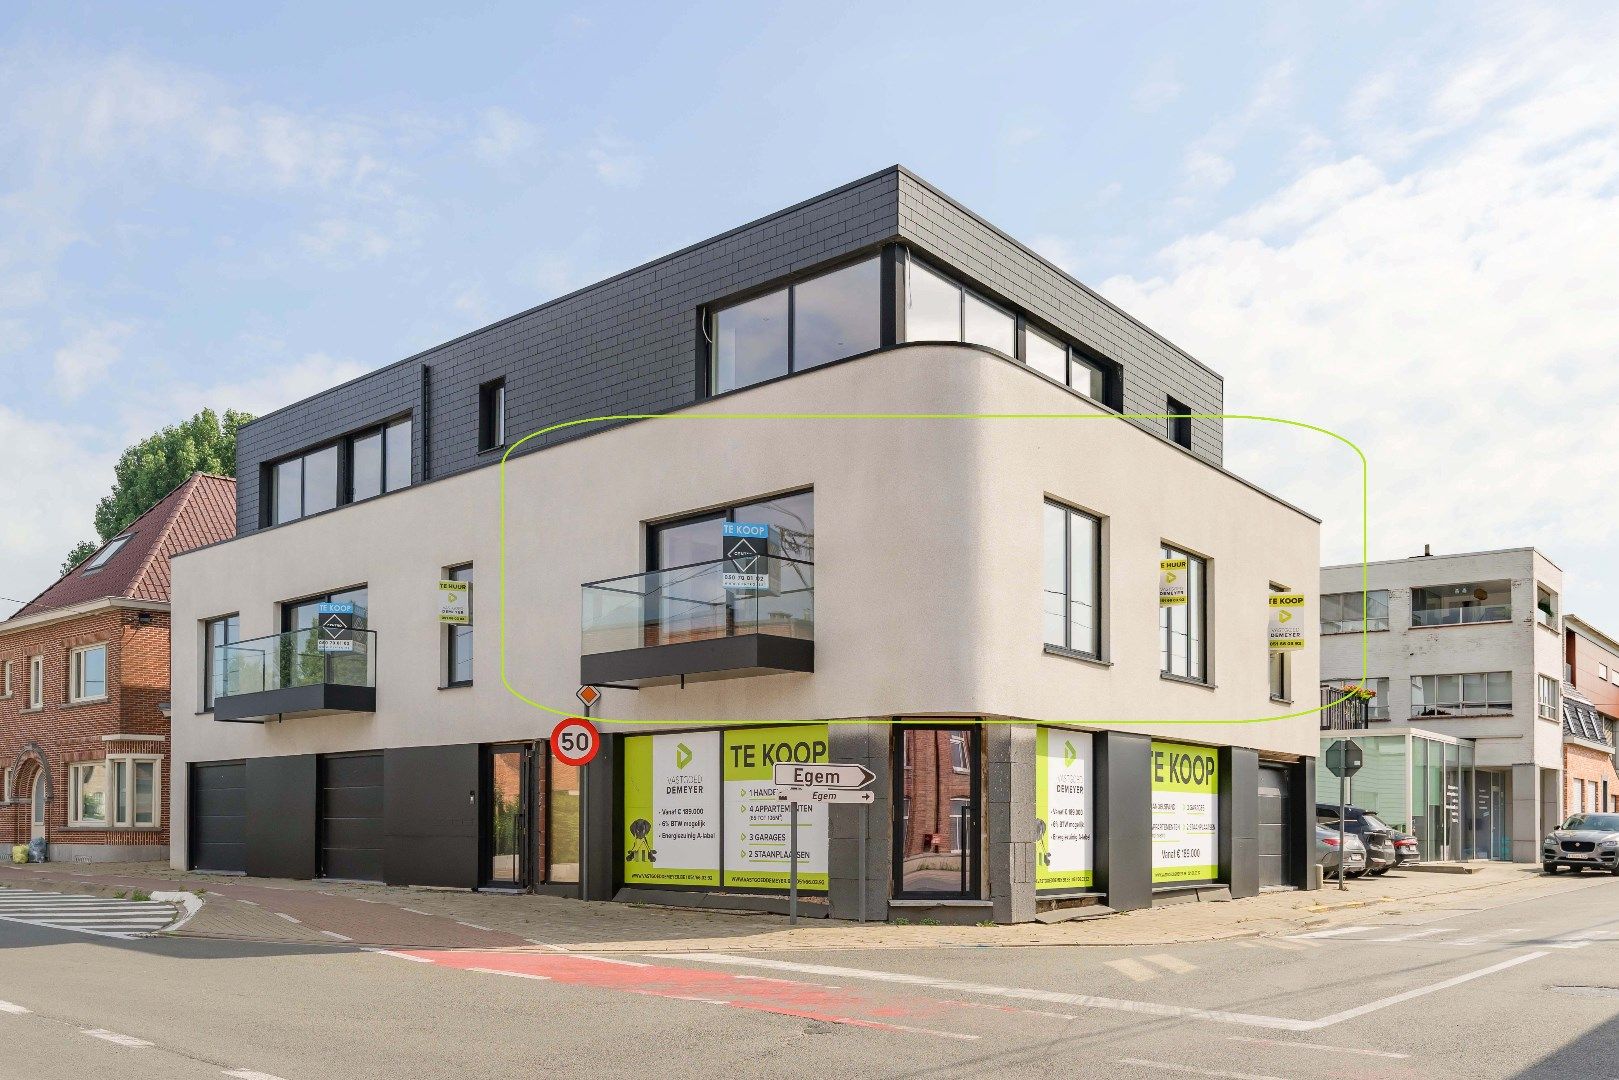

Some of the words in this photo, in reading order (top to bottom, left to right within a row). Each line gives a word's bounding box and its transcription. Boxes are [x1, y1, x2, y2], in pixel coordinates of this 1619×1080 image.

[723, 524, 734, 533] TE
[736, 525, 765, 536] KOOP
[1279, 597, 1304, 605] KOOP
[329, 604, 352, 612] KOOP
[561, 732, 589, 751] 50
[730, 744, 756, 768] TE
[762, 740, 827, 767] KOOP
[1151, 750, 1164, 783] E
[1169, 752, 1215, 786] KOOP
[793, 767, 840, 787] Egem
[666, 785, 704, 795] DEMEYER
[1056, 784, 1084, 795] DEMEYER
[812, 791, 837, 802] Egem
[755, 804, 813, 813] APPARTEMNTEN
[749, 833, 754, 841] 3
[754, 833, 786, 842] GARAGES
[748, 850, 753, 858] 2
[754, 850, 810, 859] STAANPLAASEN
